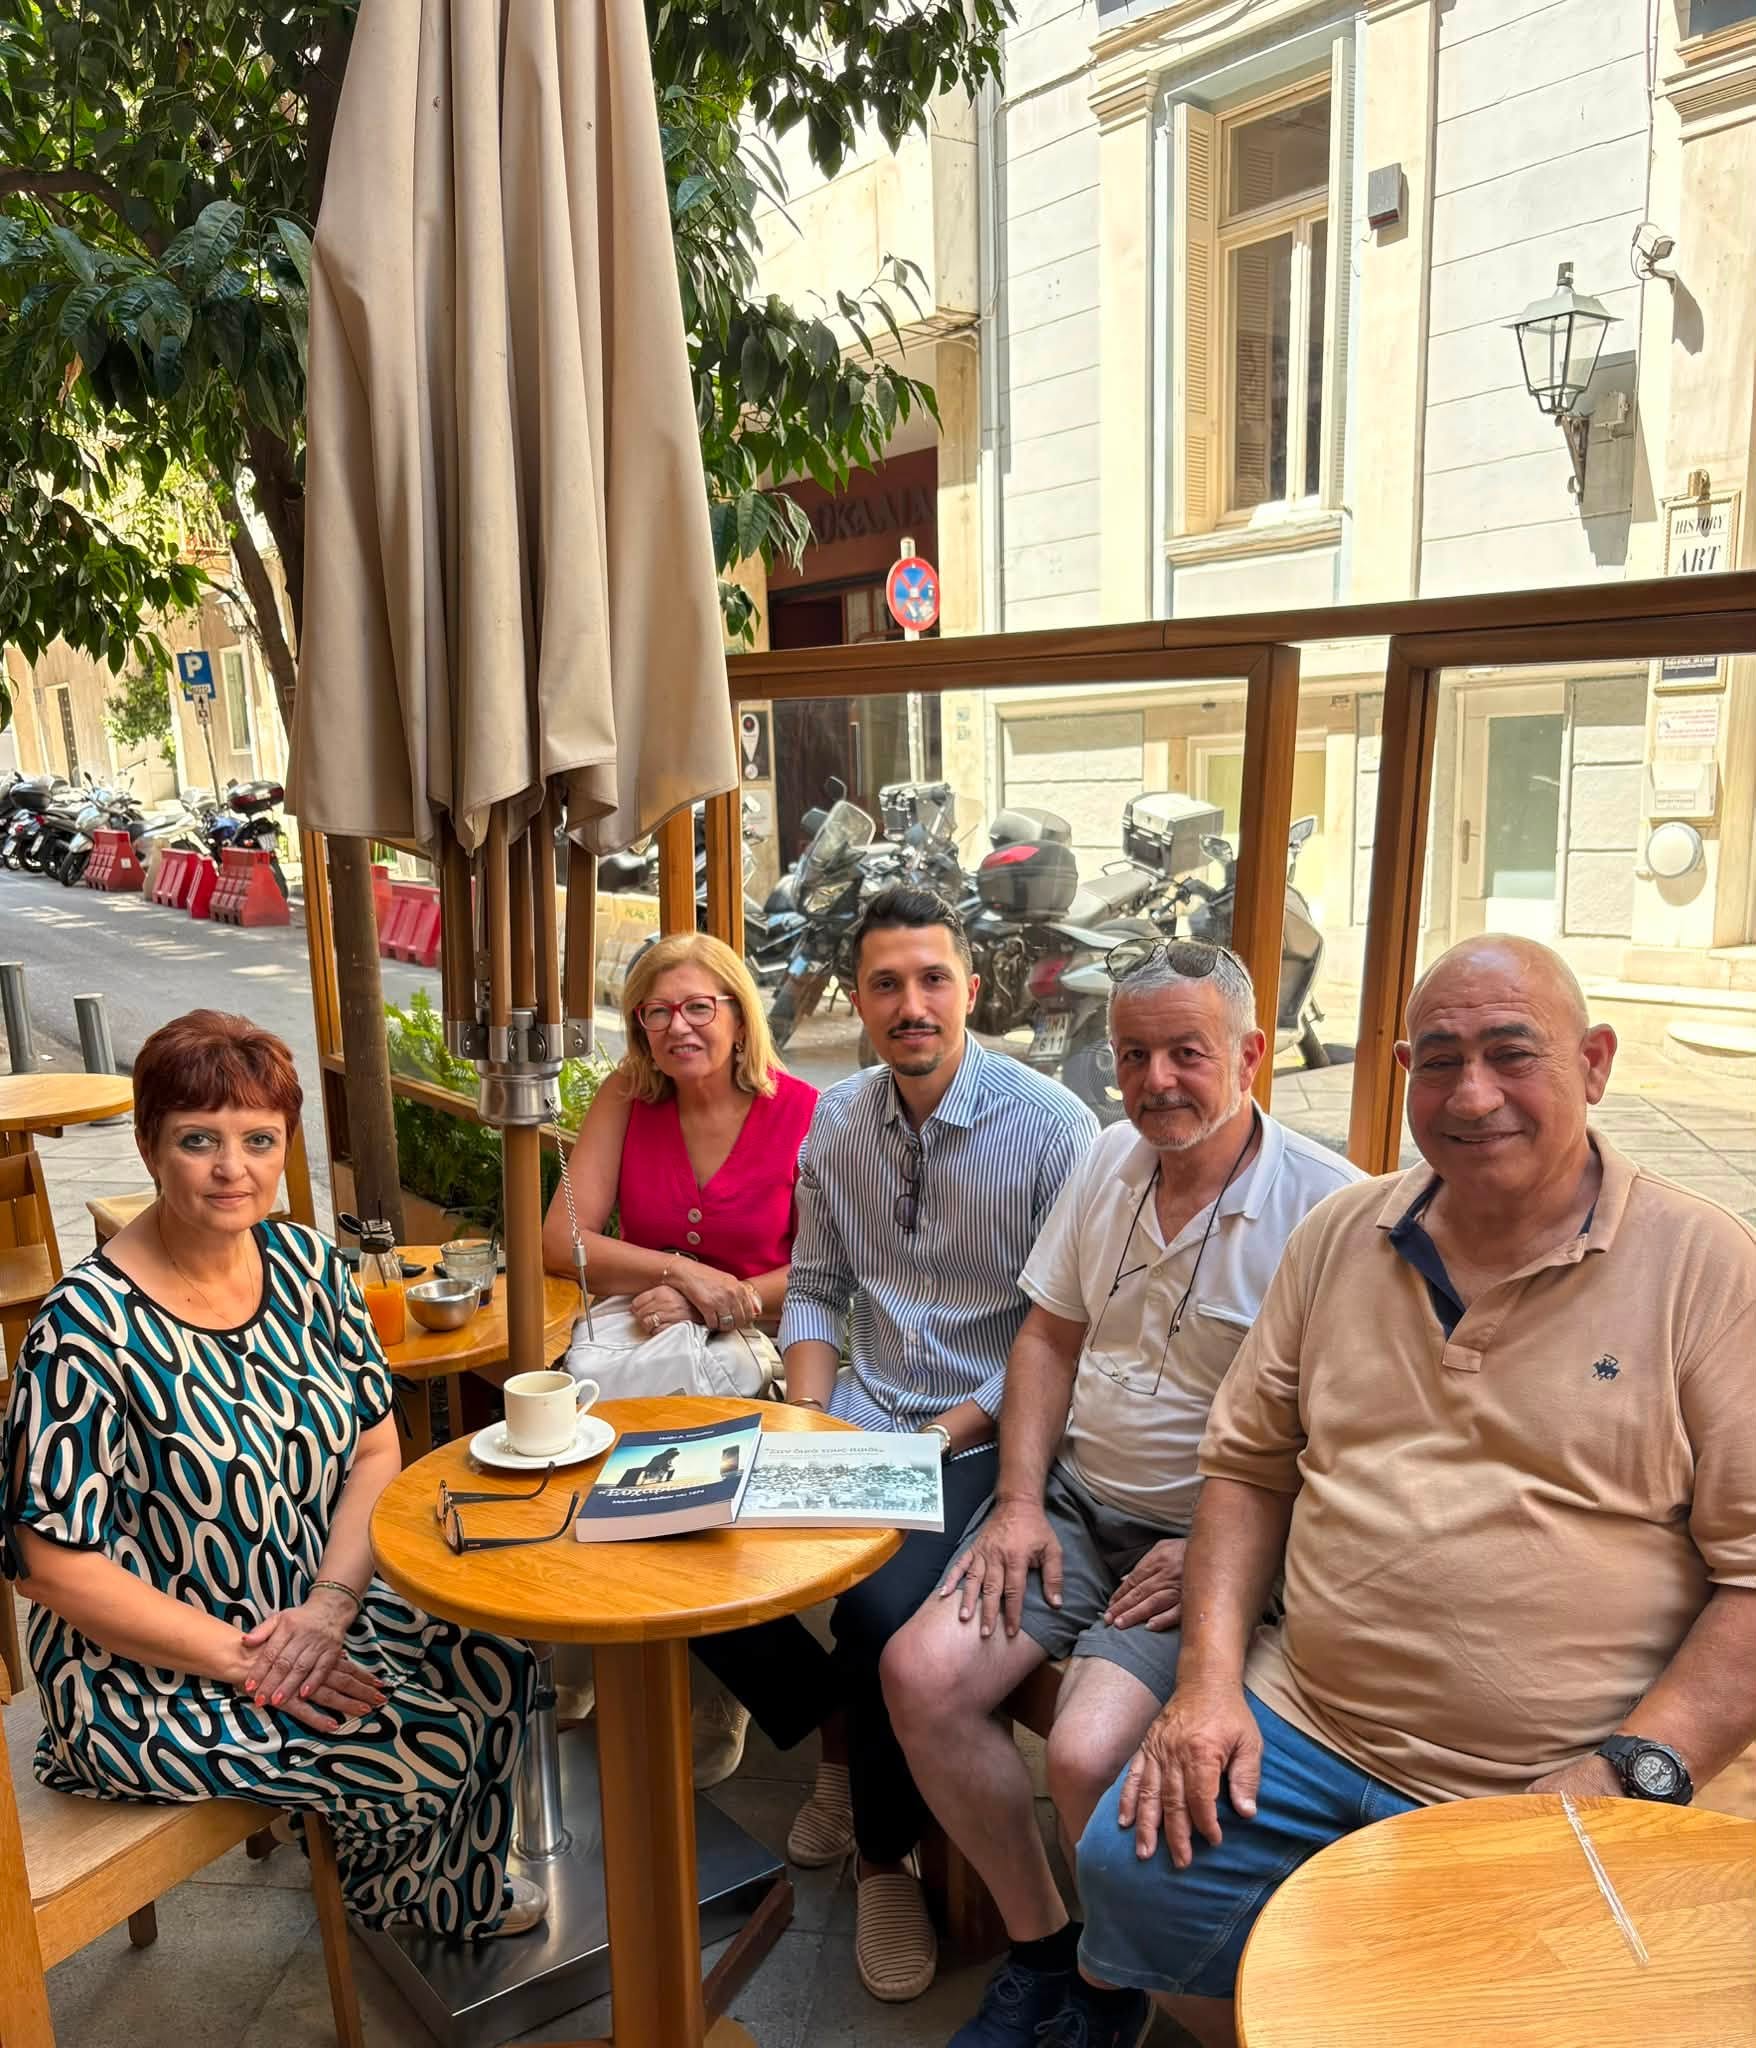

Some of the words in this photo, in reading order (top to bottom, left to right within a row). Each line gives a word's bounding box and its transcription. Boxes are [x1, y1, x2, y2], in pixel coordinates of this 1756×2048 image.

[1675, 515, 1725, 535] HISTORY
[1675, 545, 1721, 573] ART
[185, 655, 203, 678] P
